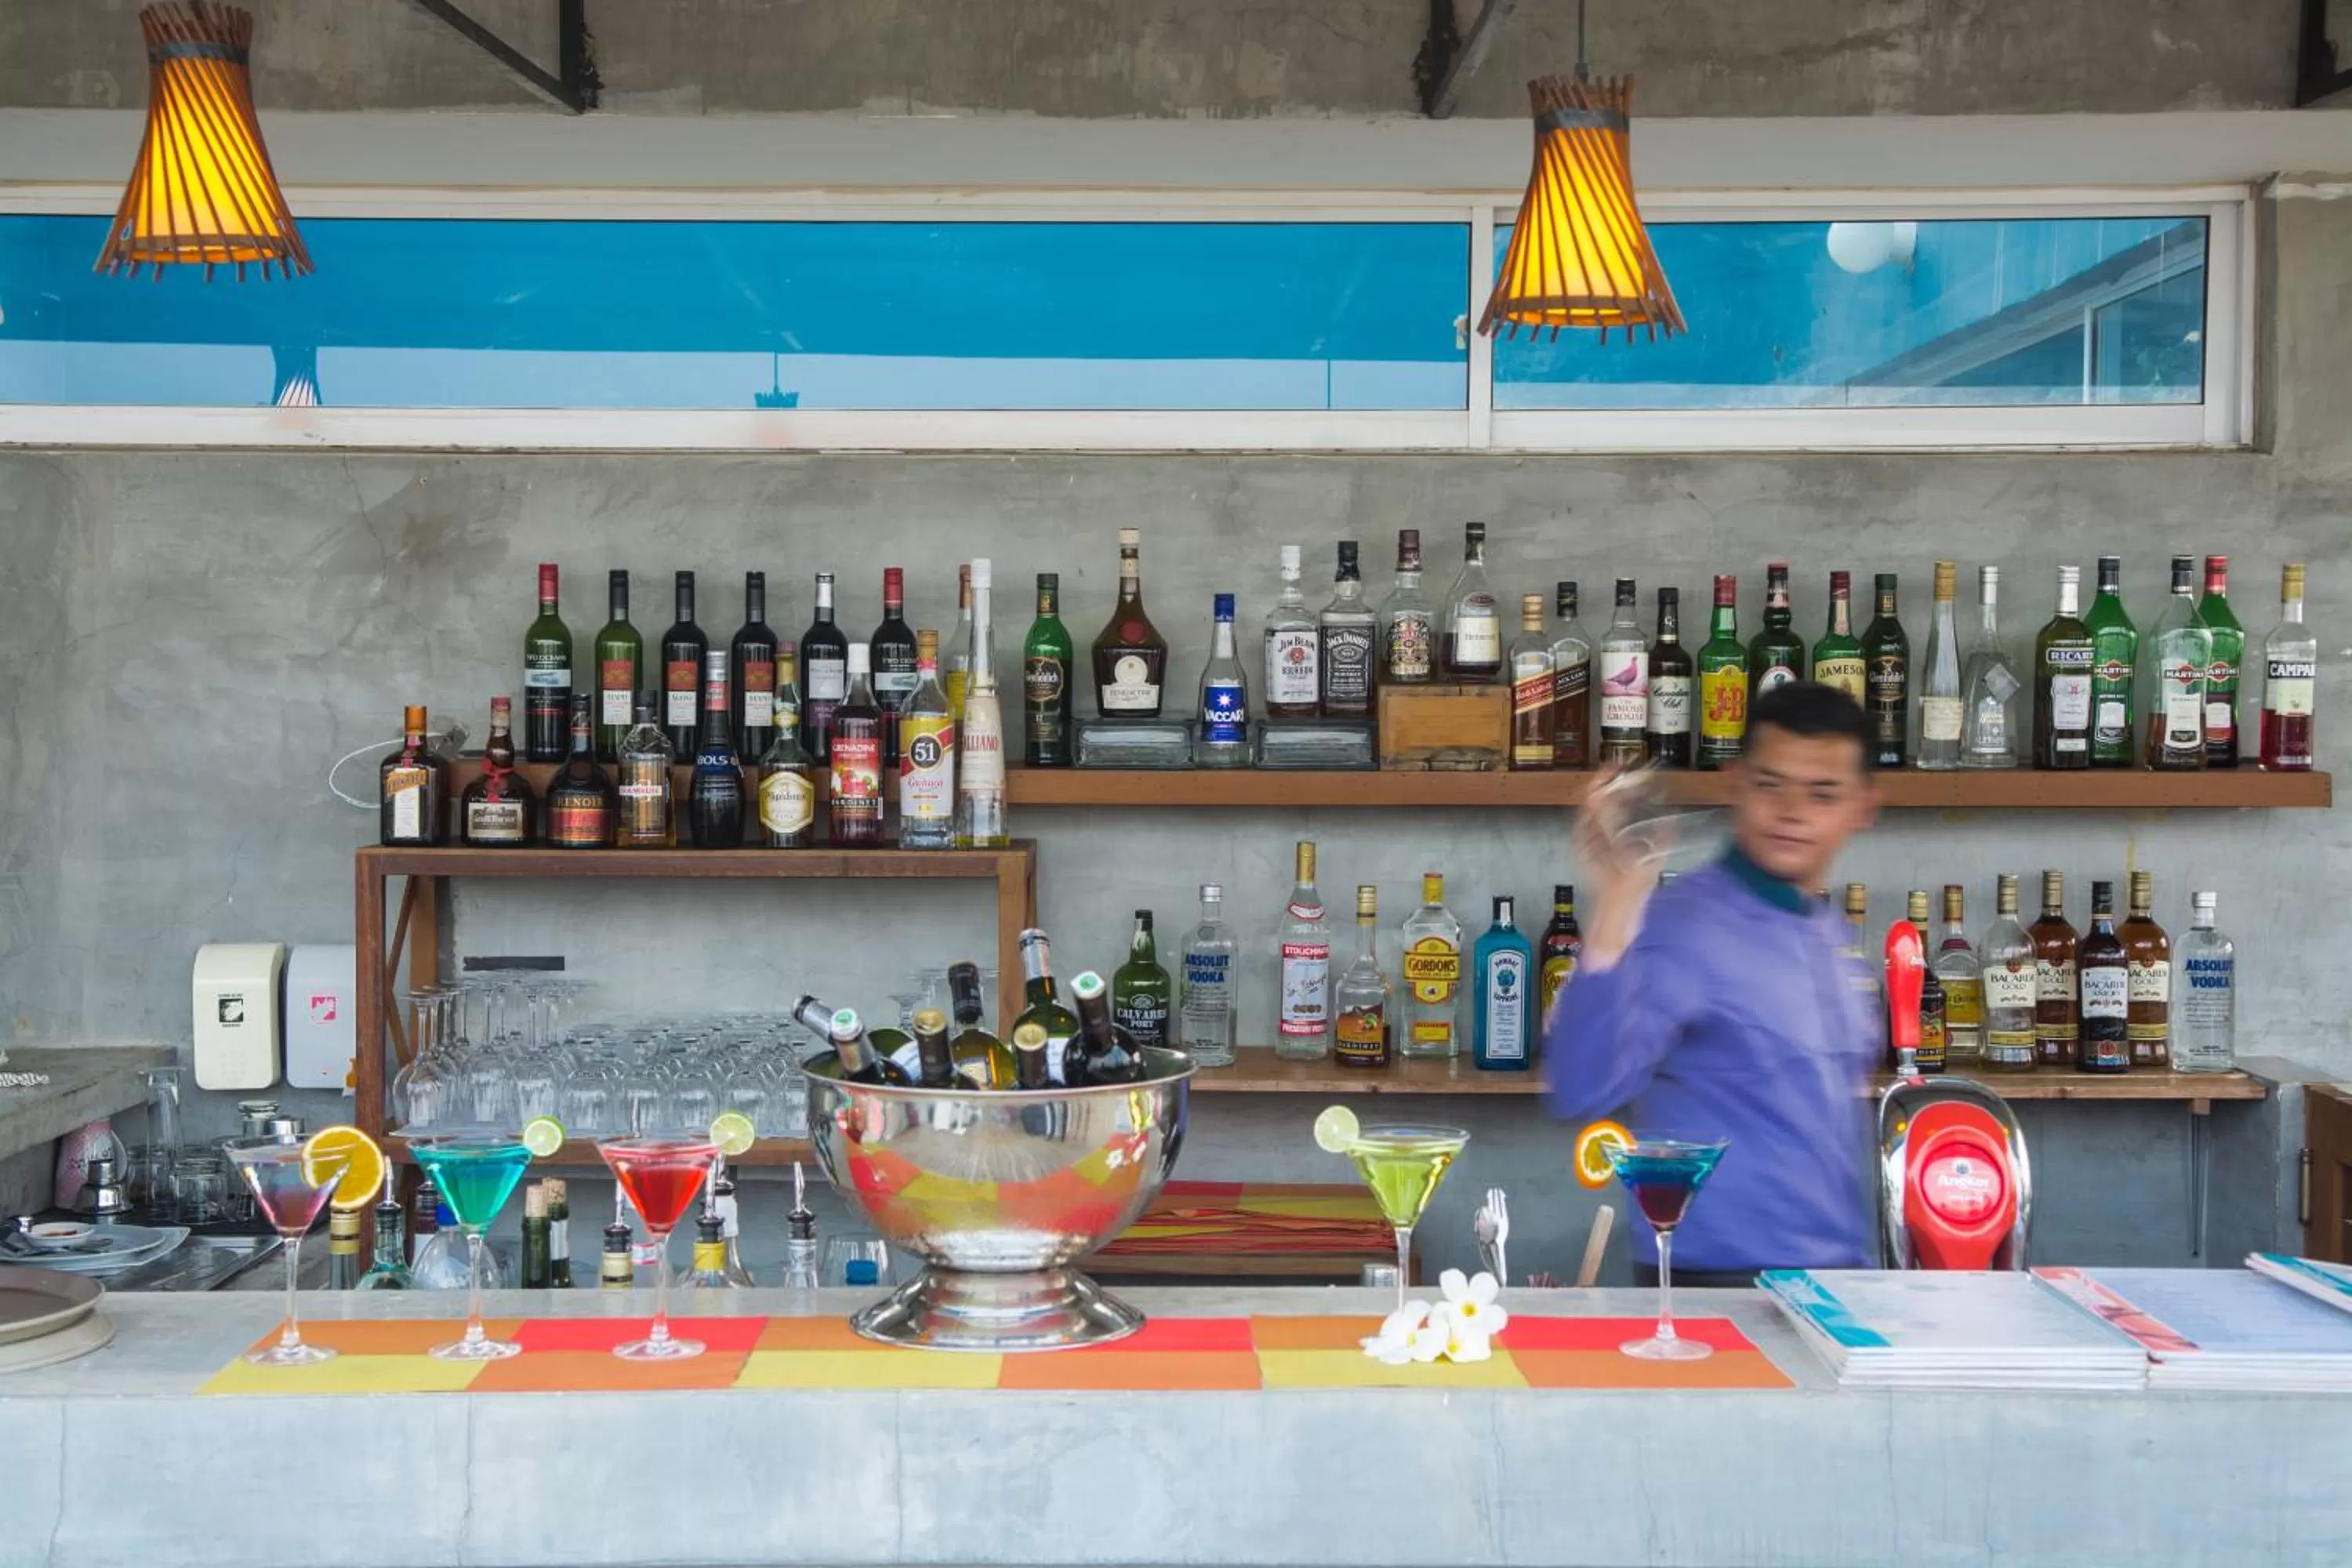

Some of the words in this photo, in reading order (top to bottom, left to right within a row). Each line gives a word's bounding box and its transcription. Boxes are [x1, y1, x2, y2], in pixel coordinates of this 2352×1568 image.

[1277, 639, 1293, 652] JIM
[1294, 636, 1315, 652] BEAM
[2050, 651, 2095, 660] RICAR
[914, 742, 936, 761] 51
[697, 755, 728, 766] BOLS
[1185, 953, 1230, 967] ABSOLUT
[2185, 959, 2233, 971] ABSOLUT
[1188, 971, 1225, 982] VODKA
[2190, 976, 2230, 988] VODKA
